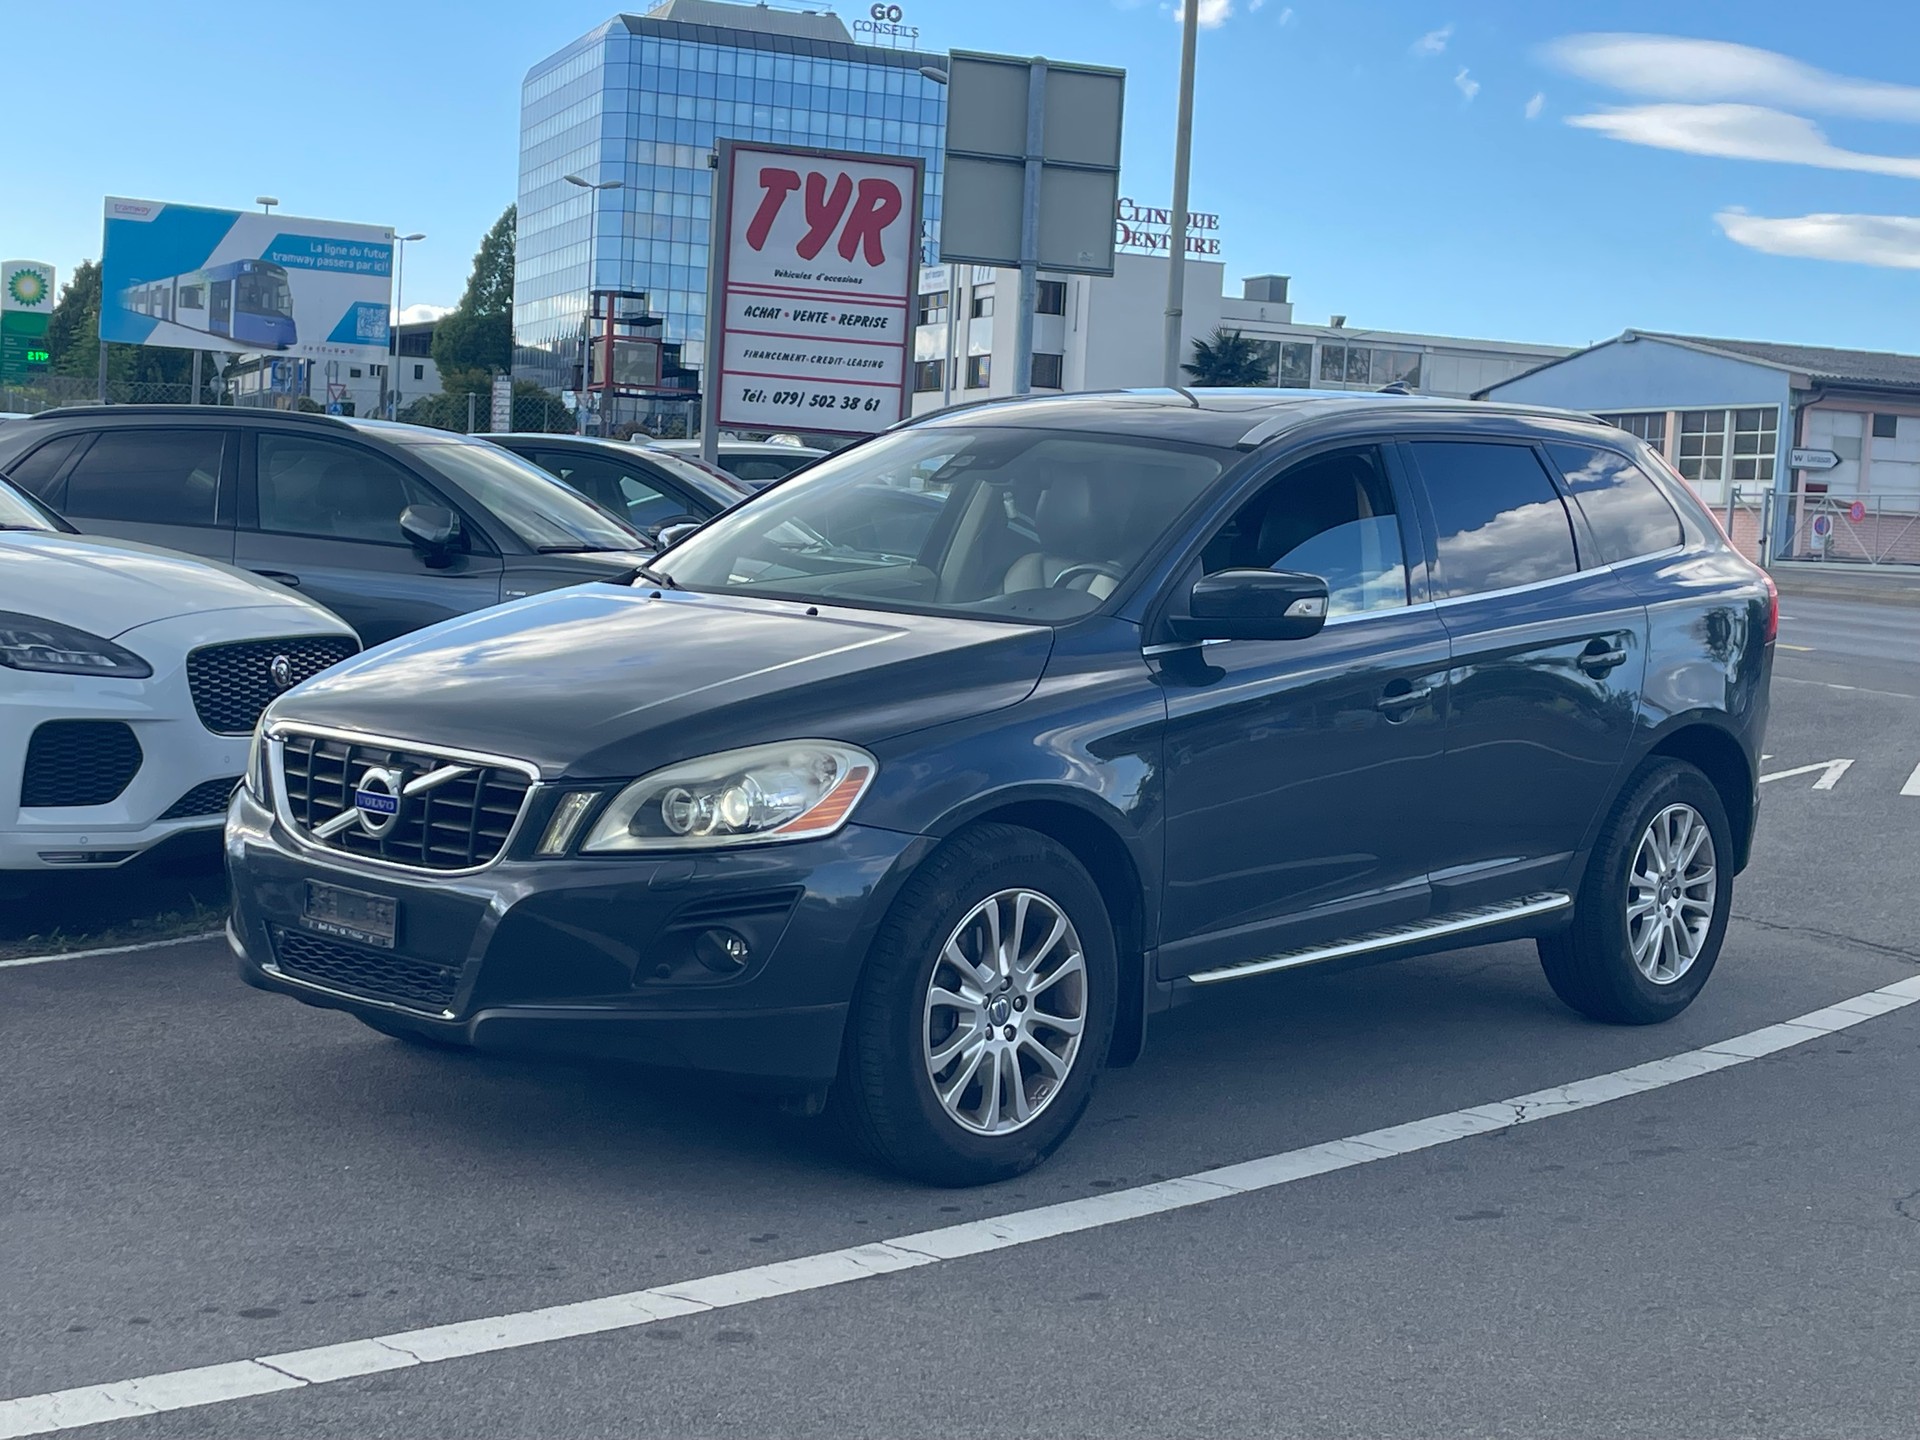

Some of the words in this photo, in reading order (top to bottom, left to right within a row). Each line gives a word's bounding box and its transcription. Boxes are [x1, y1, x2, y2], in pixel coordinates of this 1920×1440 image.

[870, 3, 902, 22] GO
[853, 20, 919, 38] CONSEILS
[746, 168, 902, 267] TYR
[1117, 198, 1220, 230] CLINUE
[1115, 222, 1220, 254] DENTIRE
[310, 242, 321, 253] La
[324, 243, 347, 256] ligne
[349, 246, 361, 256] du
[364, 248, 389, 259] futur
[272, 252, 314, 267] tramway
[317, 257, 354, 270] passera
[356, 262, 371, 271] par
[816, 273, 863, 285] d'occasions
[744, 305, 782, 319] ACHAT
[792, 310, 829, 324] VENTE
[838, 313, 888, 329] REPRISE
[847, 358, 884, 369] LEASING
[742, 388, 767, 403] Tél:
[809, 394, 837, 409] 502
[840, 396, 861, 410] 38
[864, 398, 881, 412] 61
[357, 794, 395, 810] VOLVO
